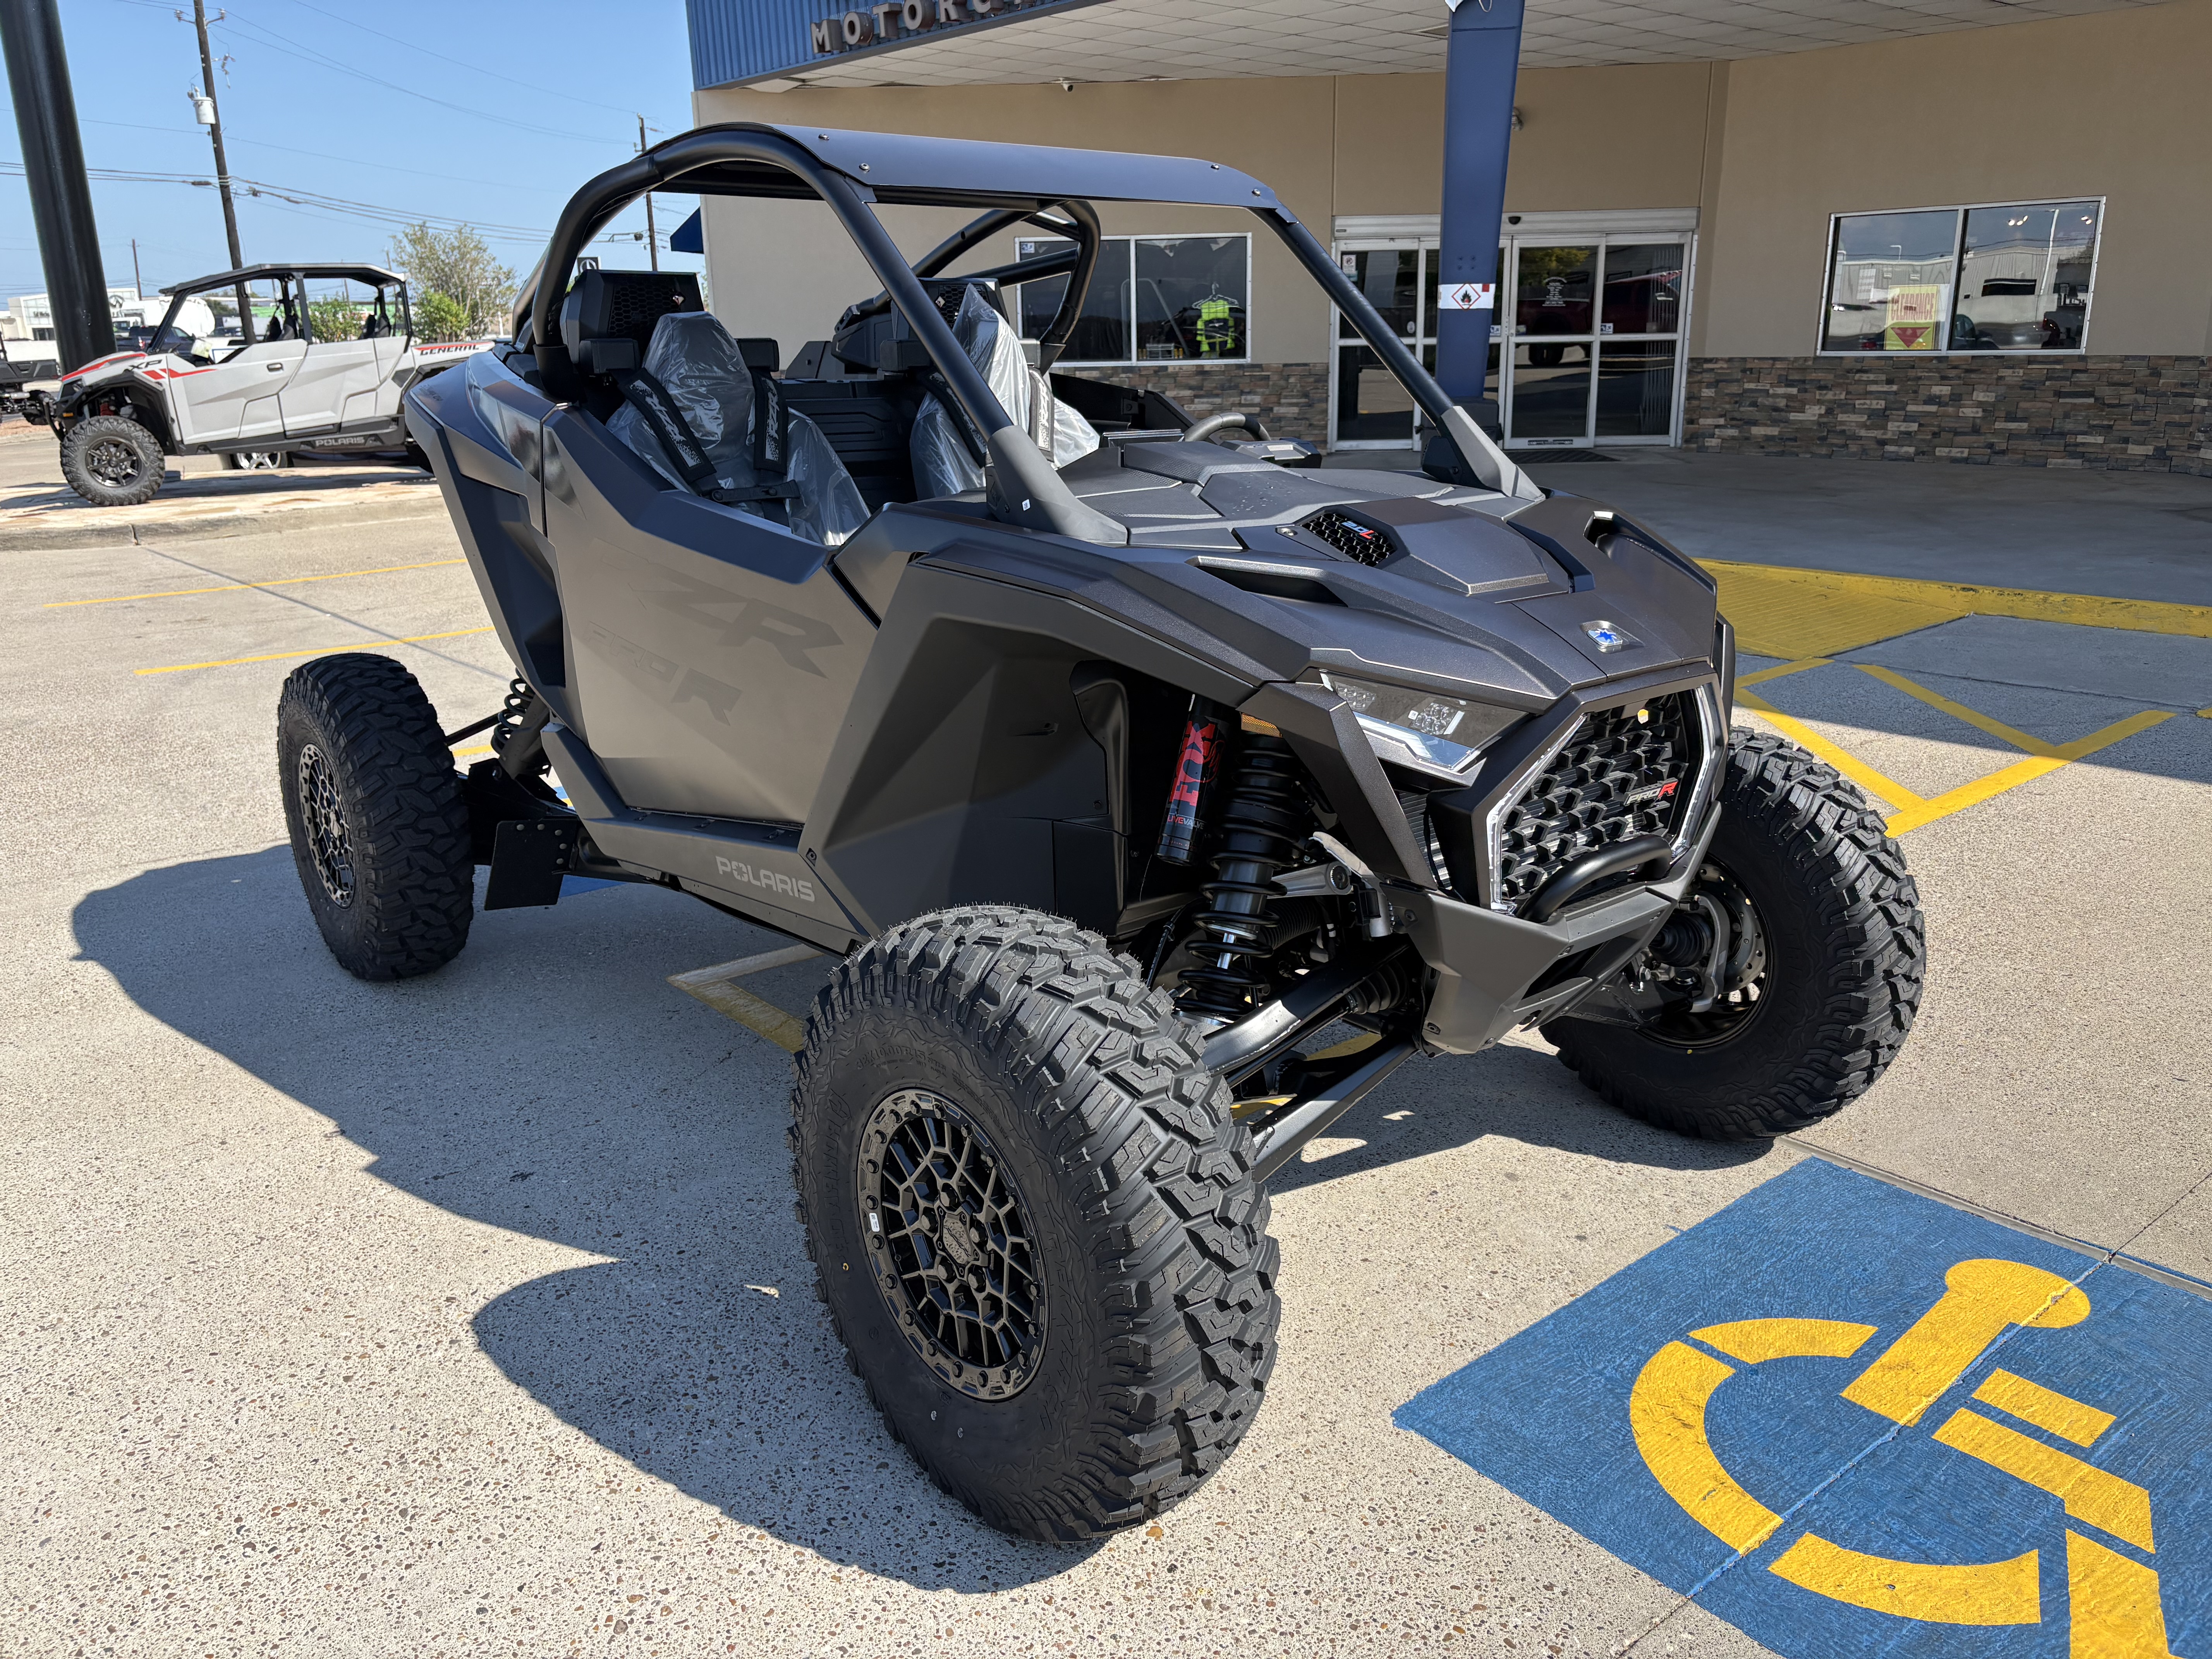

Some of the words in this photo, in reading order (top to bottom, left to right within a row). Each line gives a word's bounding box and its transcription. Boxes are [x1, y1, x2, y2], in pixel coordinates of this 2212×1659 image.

[811, 0, 1032, 53] MOTOR
[1891, 292, 1935, 321] CLEARANCE
[129, 359, 163, 371] XP
[420, 344, 479, 356] GENERAL
[645, 394, 687, 441] RZR
[766, 391, 780, 440] RZR
[315, 436, 365, 447] POLARIS
[582, 620, 680, 684] PRO
[671, 668, 744, 726] R
[1169, 721, 1216, 806] FOX
[715, 855, 815, 902] POLARIS
